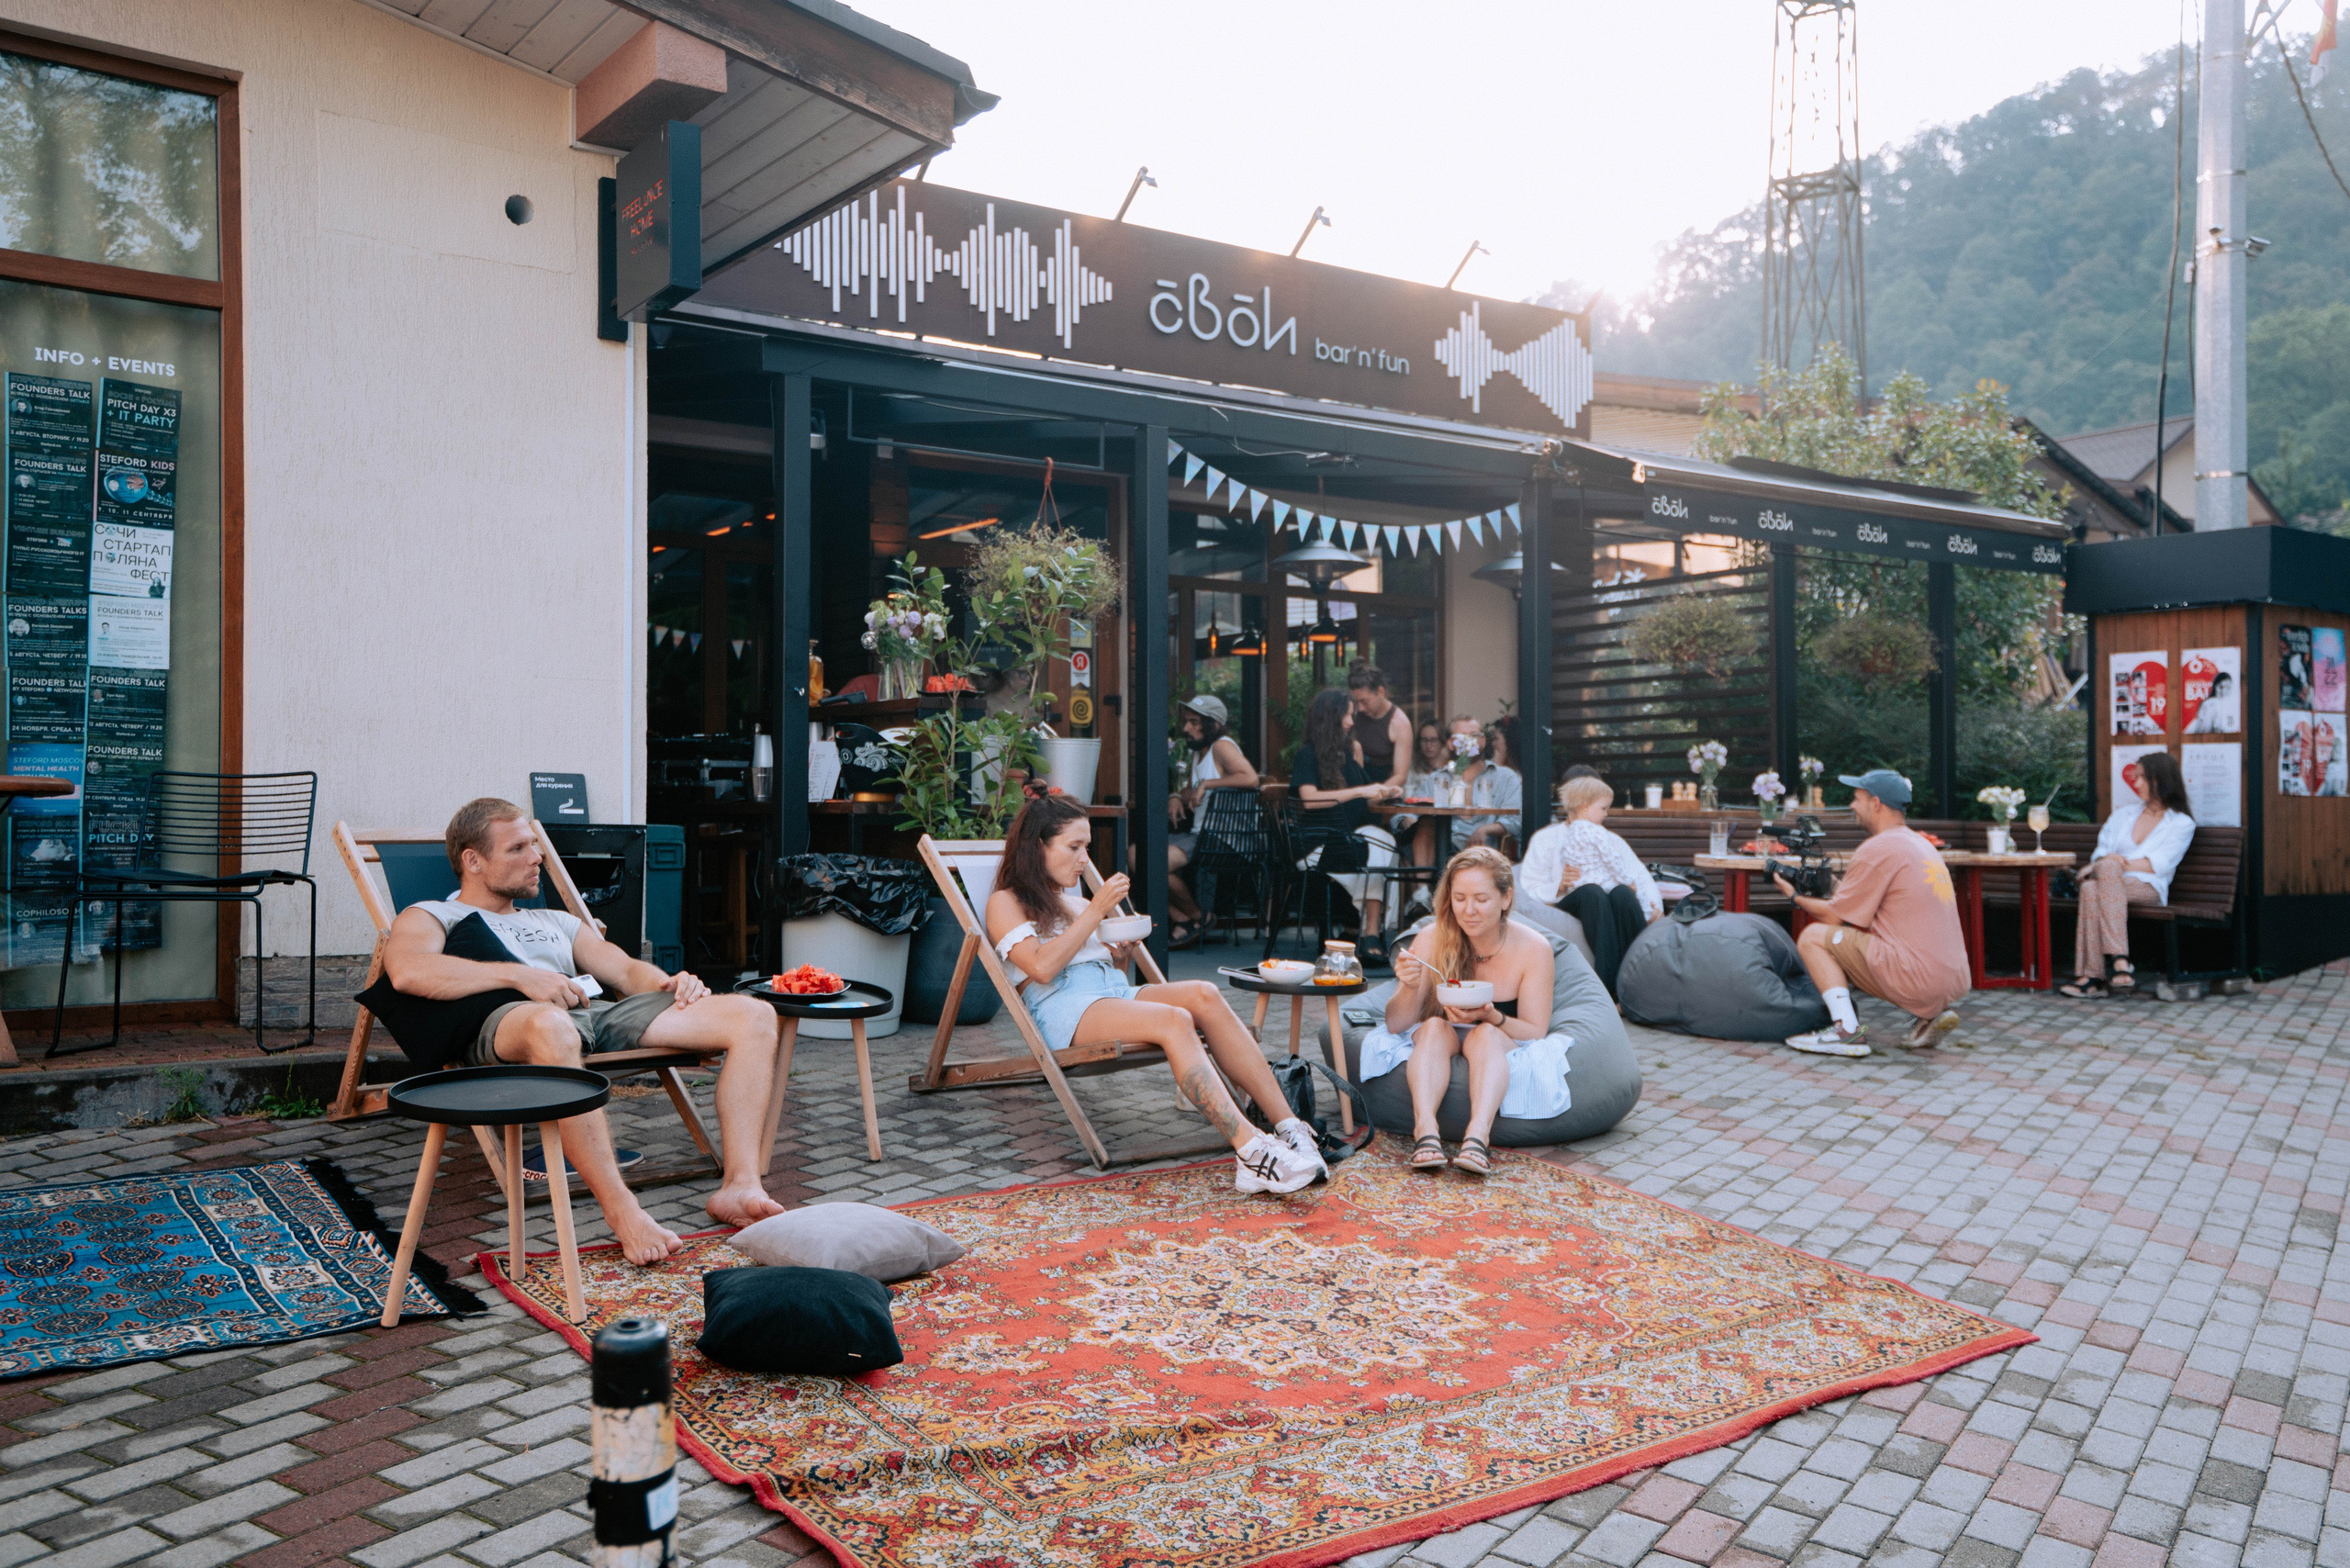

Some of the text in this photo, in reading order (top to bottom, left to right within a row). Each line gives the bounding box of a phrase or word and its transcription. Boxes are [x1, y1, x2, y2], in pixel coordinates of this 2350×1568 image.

[35, 347, 84, 365] INFO
[108, 356, 175, 376] EVENTS
[1315, 338, 1409, 375] bar'n'fun
[10, 383, 90, 399] FOUNDERS TALK
[107, 398, 177, 417] PITCH DAY X3
[119, 409, 130, 420] IT
[134, 412, 175, 428] PARTY
[15, 459, 63, 471] FOUNDERS
[66, 464, 87, 473] TALK
[99, 454, 147, 467] STEFORD
[151, 460, 175, 471] KIDS
[133, 510, 173, 520] СЕНТЯБРЯ
[104, 539, 171, 556] СТАРТАП
[130, 569, 170, 582] ФЕСТ
[8, 604, 59, 614] FOUNDERS
[97, 607, 141, 616] FOUNDERS
[13, 678, 65, 687] FOUNDERS
[91, 676, 141, 686] FOUNDERS
[2150, 697, 2166, 713] 19
[87, 745, 162, 756] FOUNDERS TALK
[89, 834, 124, 843] PITCH
